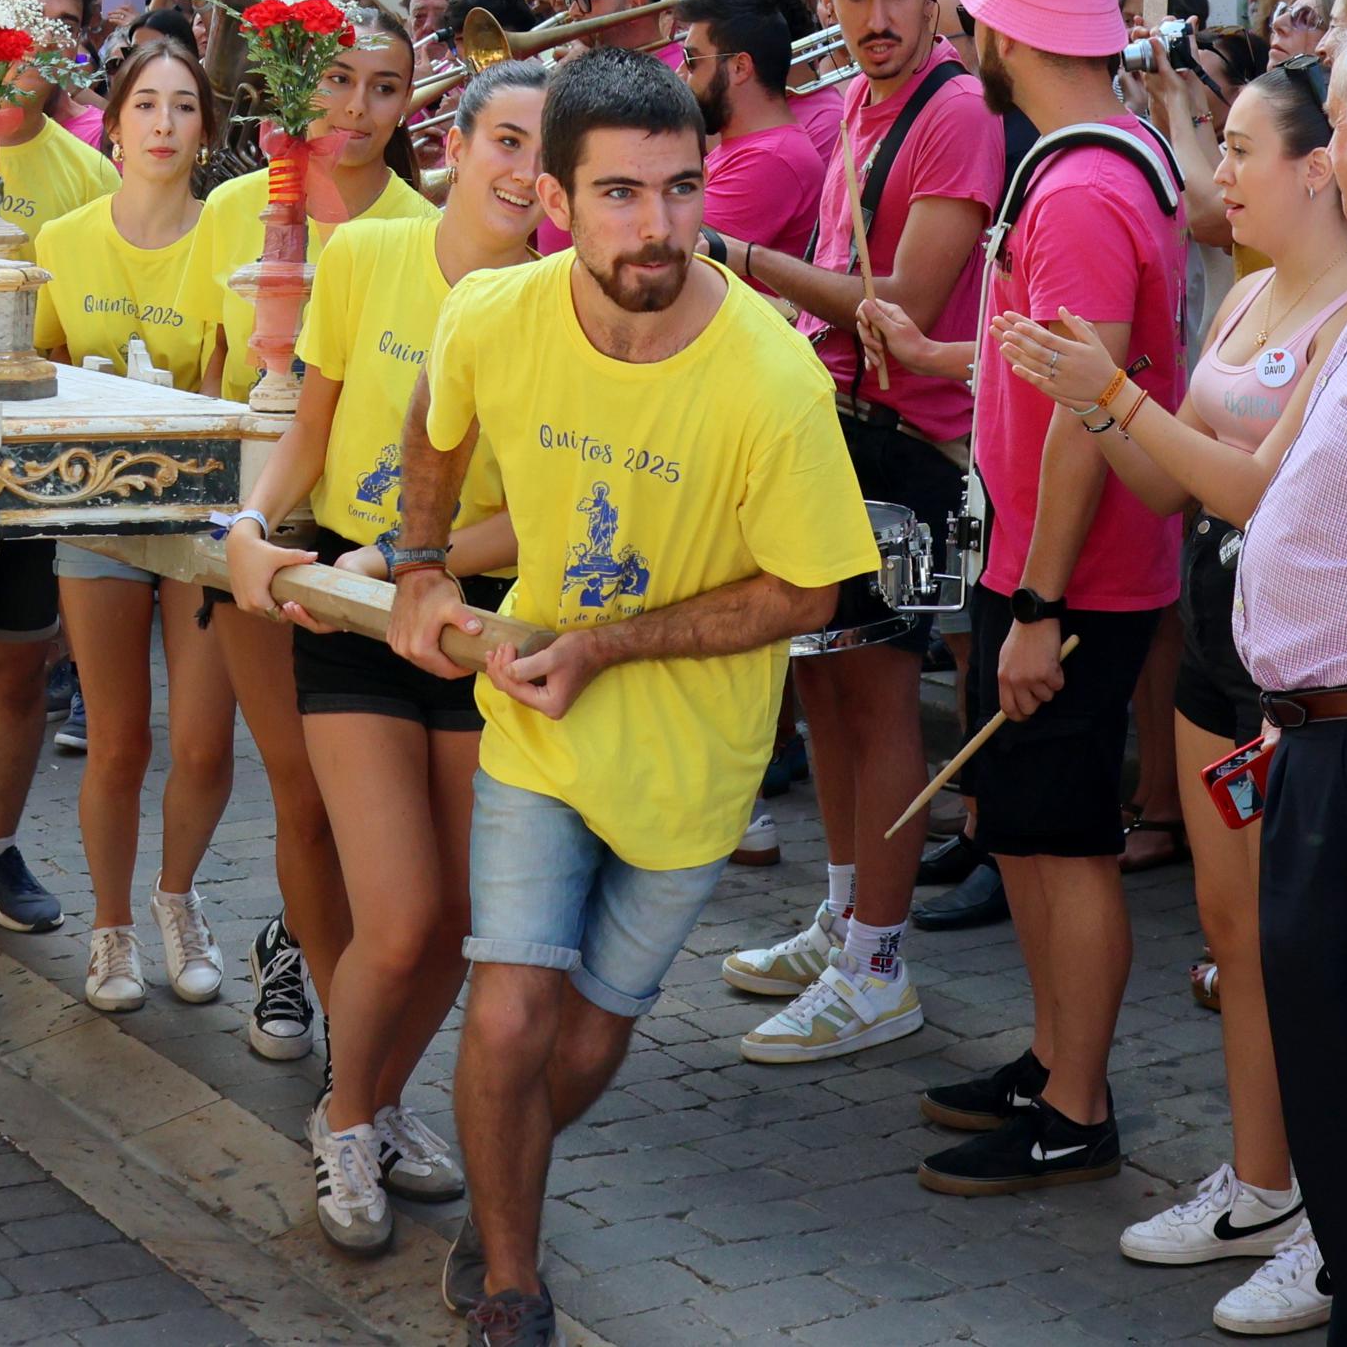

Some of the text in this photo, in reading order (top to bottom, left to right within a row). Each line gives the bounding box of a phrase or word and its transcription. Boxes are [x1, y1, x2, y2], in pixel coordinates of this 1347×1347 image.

[0, 195, 37, 218] 025
[139, 305, 184, 327] 2025
[379, 330, 429, 365] Quin
[1264, 364, 1286, 375] DAVID
[623, 448, 681, 483] 2025
